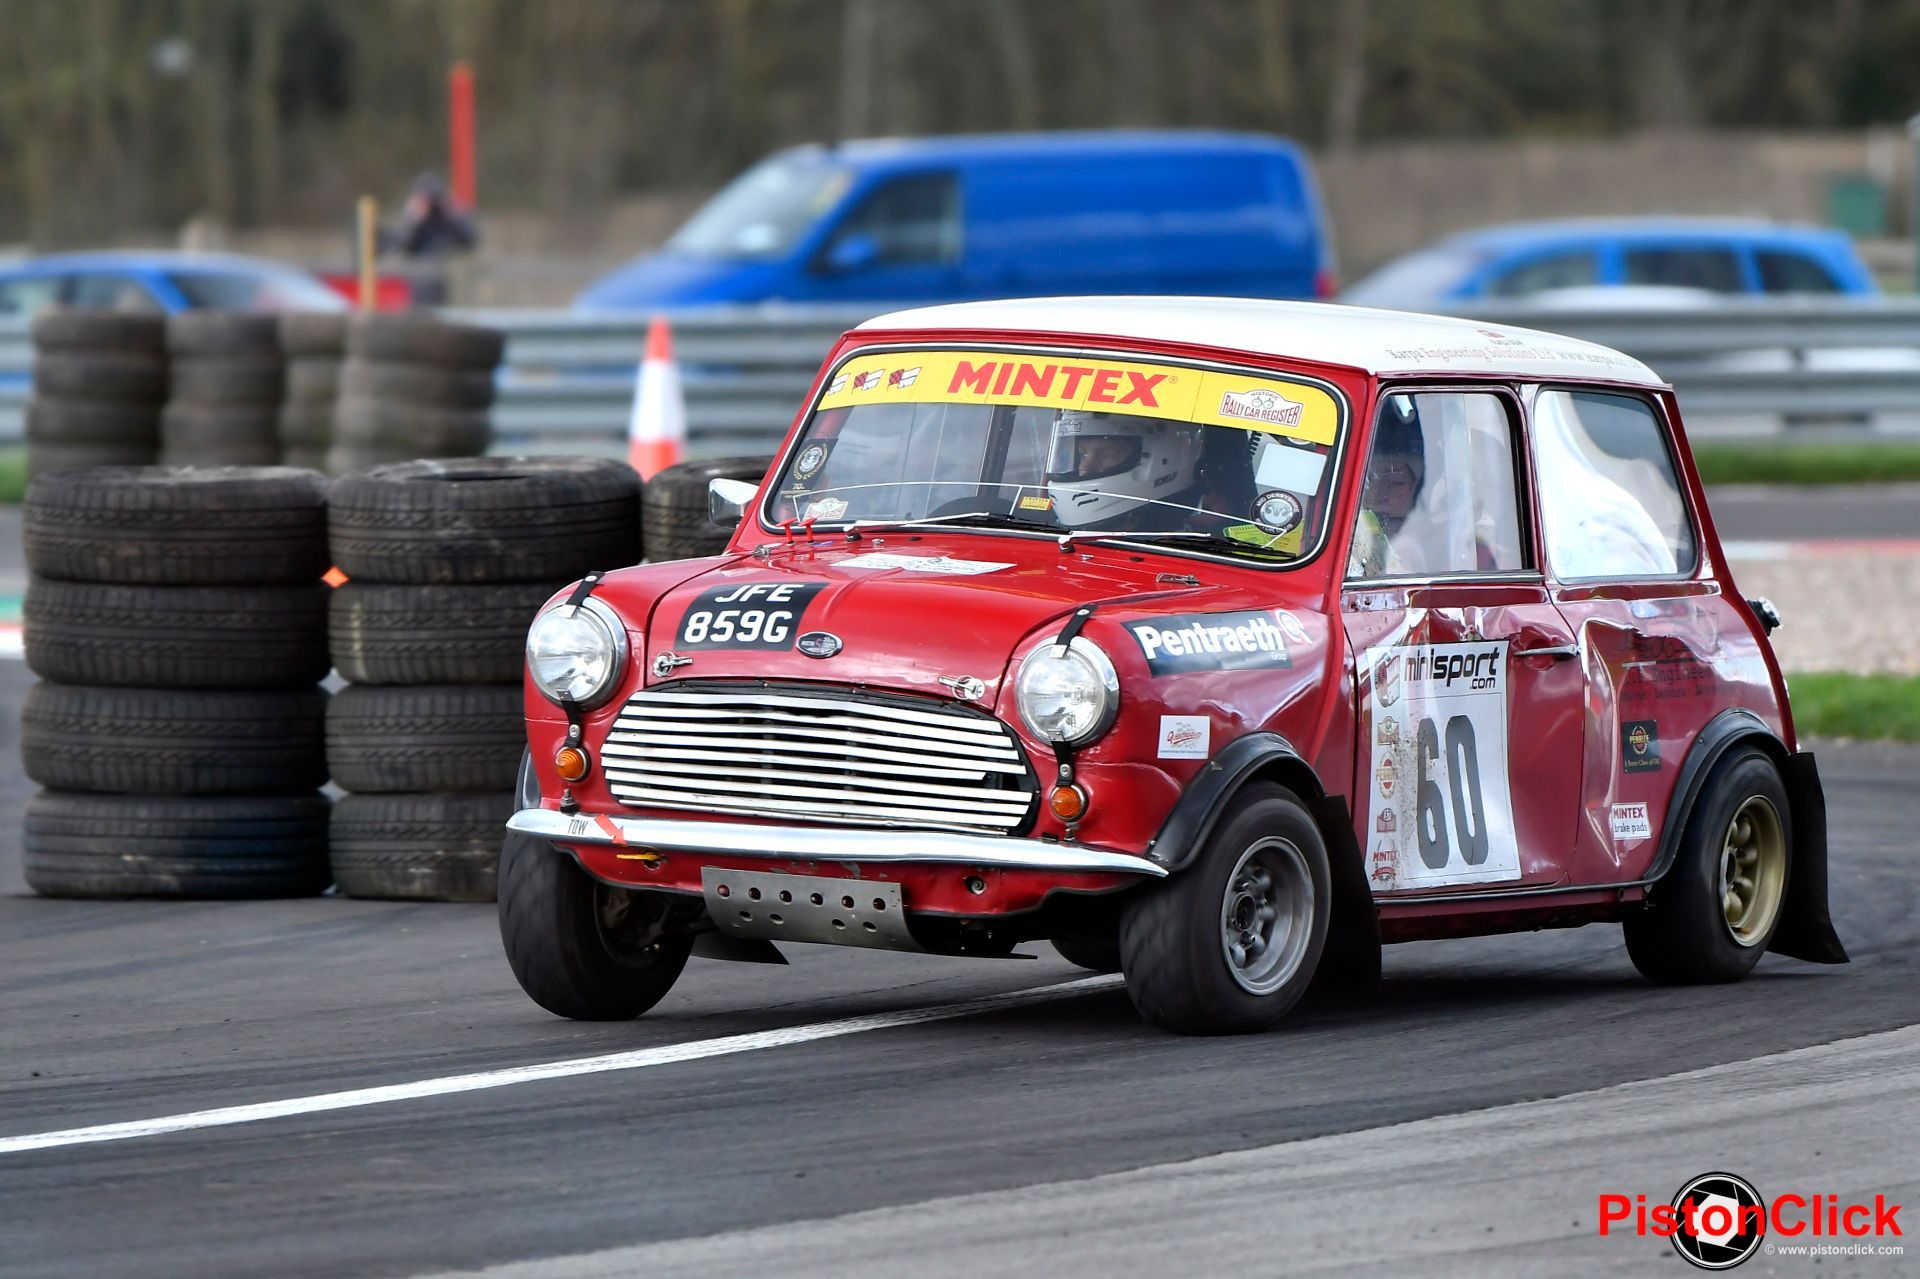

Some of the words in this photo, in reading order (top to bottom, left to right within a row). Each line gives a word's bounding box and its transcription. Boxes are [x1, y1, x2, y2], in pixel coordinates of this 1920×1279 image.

[1424, 346, 1491, 363] Engineering
[1489, 347, 1536, 360] Solutions
[947, 360, 1168, 408] MINTEX
[1222, 394, 1244, 415] RALLY
[1245, 406, 1260, 418] CAR
[1261, 405, 1300, 425] REGISTER
[1256, 496, 1267, 507] MID
[1266, 493, 1300, 513] DERBYSHIRE
[714, 584, 804, 603] JFE
[684, 610, 793, 643] 859G
[1133, 617, 1286, 660] Pentraeth
[1271, 652, 1288, 662] Group
[1404, 646, 1500, 687] minisport
[1469, 676, 1496, 690] .com
[1629, 734, 1650, 745] PENRITE
[1416, 714, 1490, 870] 60
[1613, 804, 1645, 820] MINTEX
[568, 819, 589, 835] TOW
[1614, 821, 1632, 834] brake
[1633, 821, 1648, 836] pads
[1372, 849, 1399, 862] MINTEX
